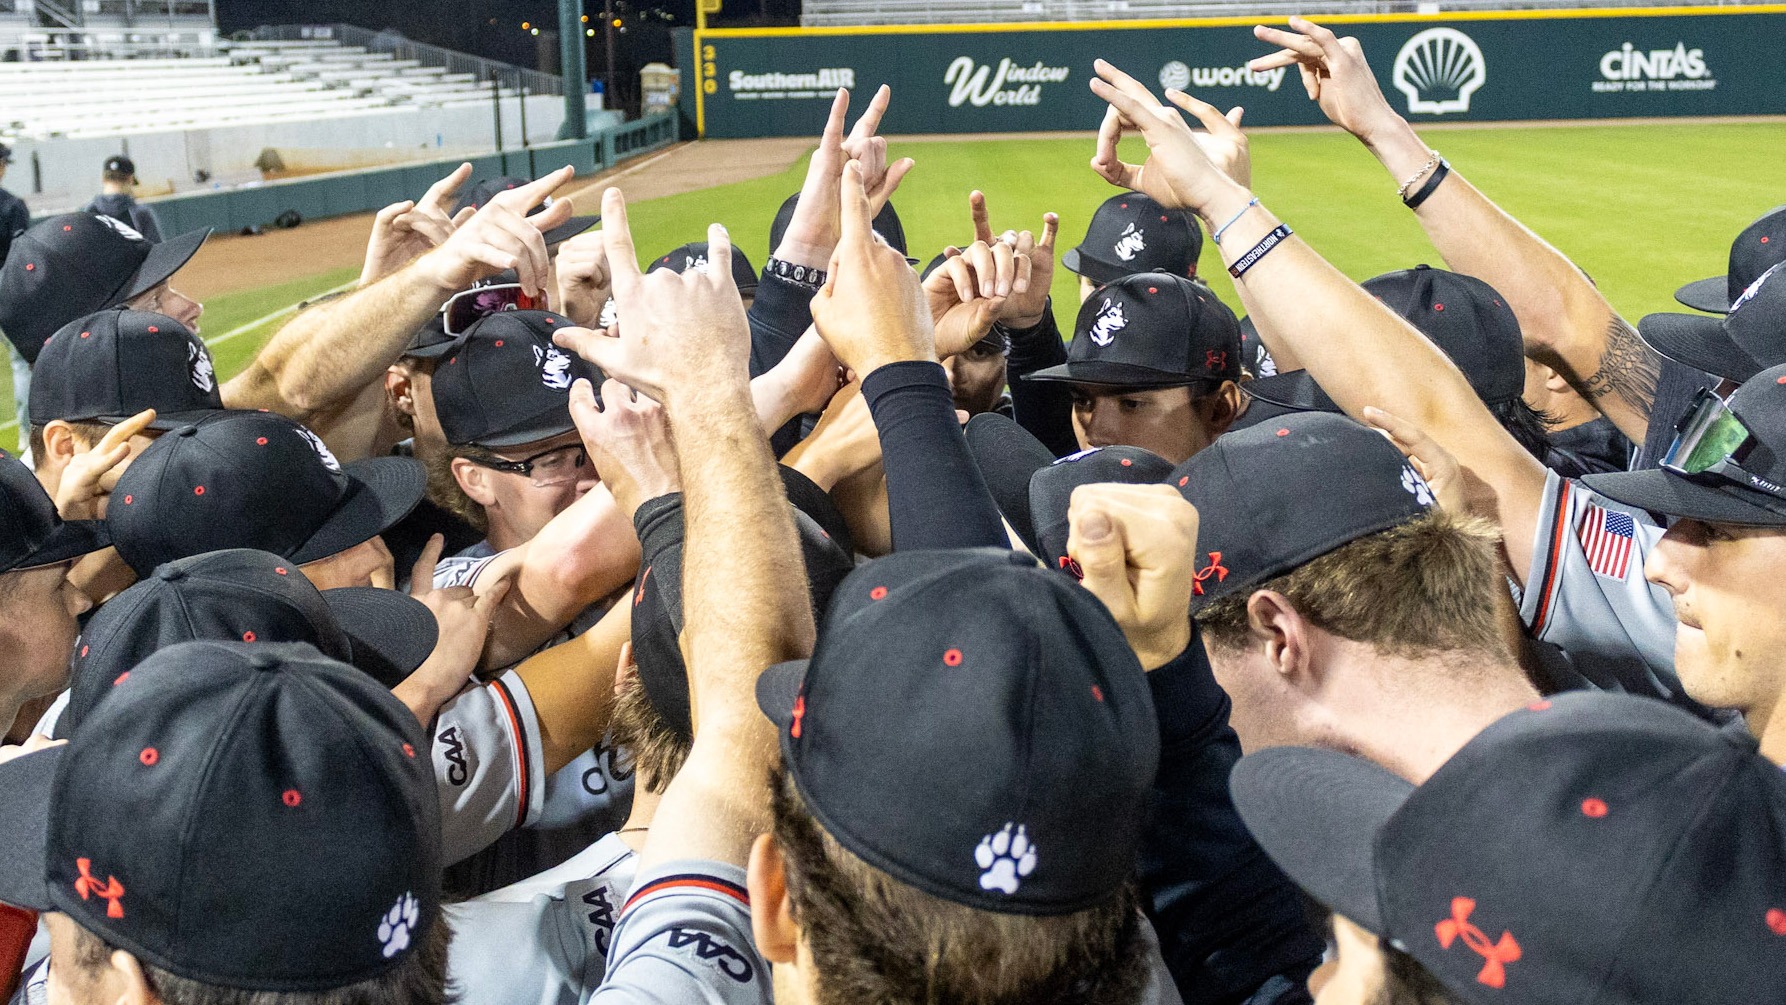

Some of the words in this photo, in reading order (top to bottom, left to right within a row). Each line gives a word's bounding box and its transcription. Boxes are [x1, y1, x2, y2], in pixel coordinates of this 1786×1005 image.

[944, 56, 1069, 107] Window
[1191, 61, 1286, 92] worley
[1235, 233, 1279, 273] NORTHEASTERN
[438, 726, 467, 786] CAA
[668, 927, 753, 983] CAA
